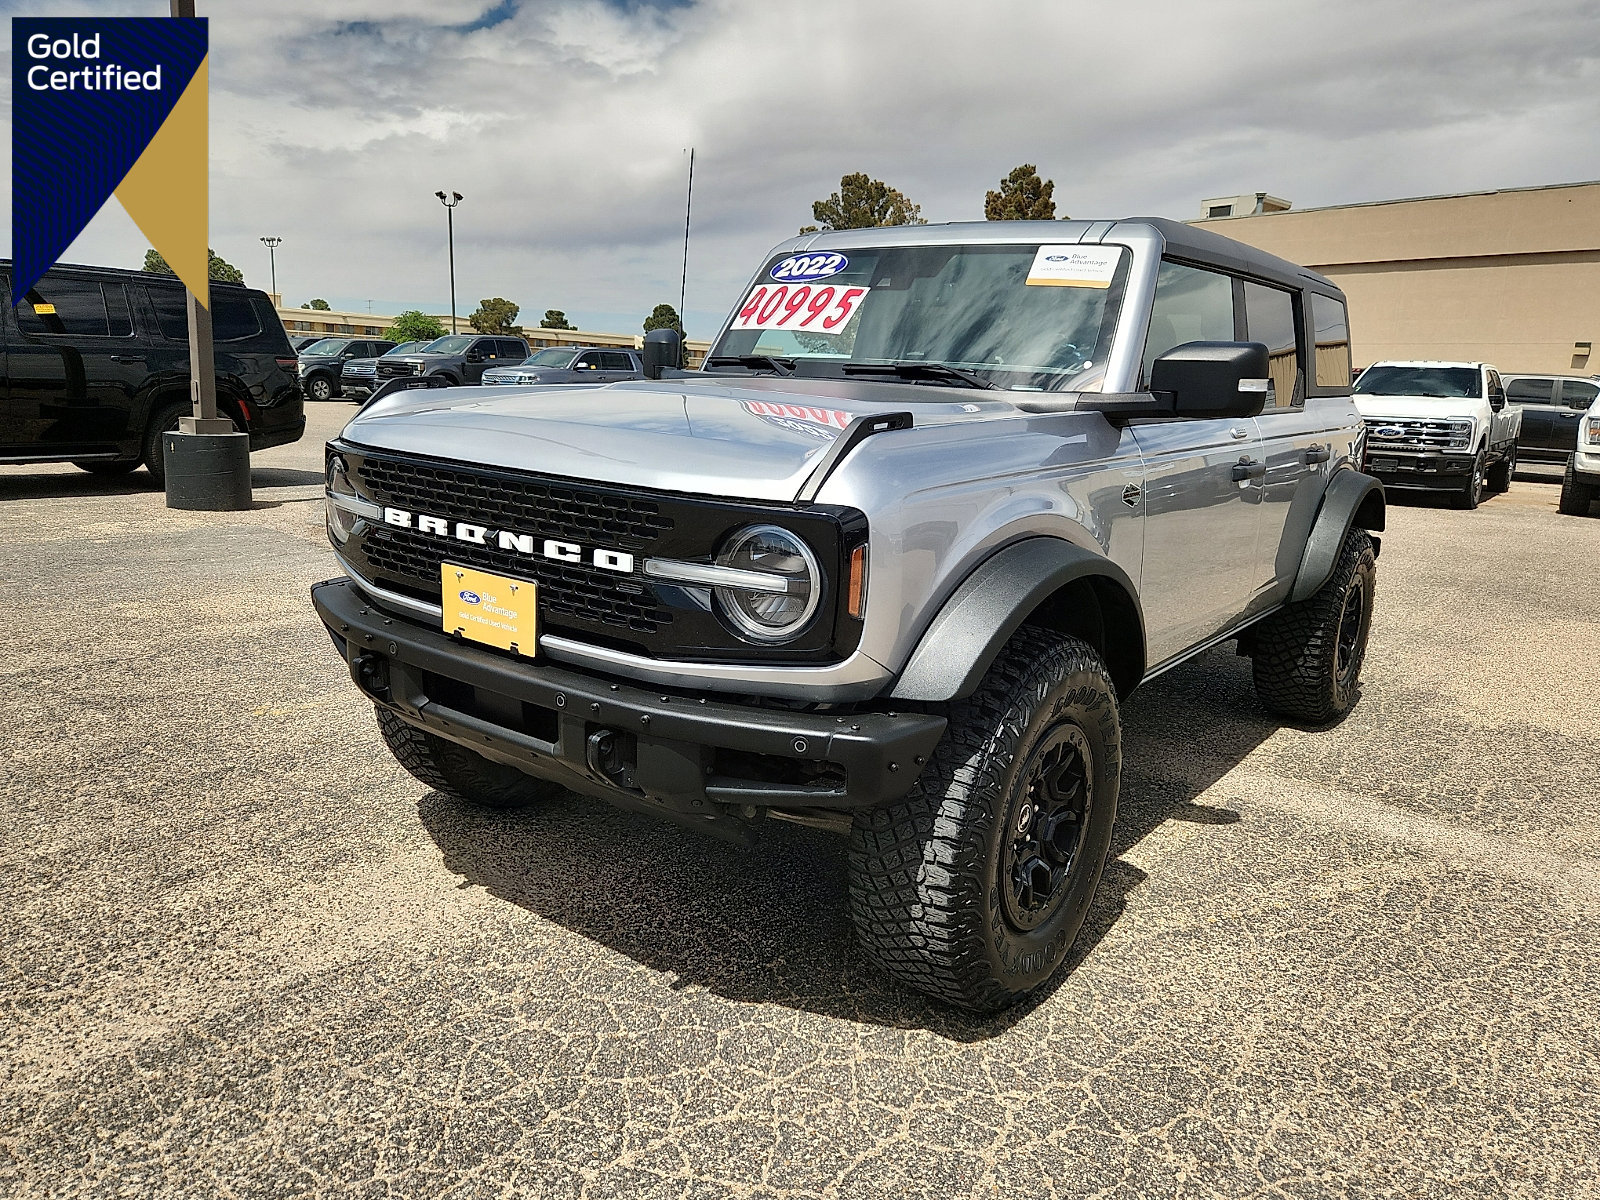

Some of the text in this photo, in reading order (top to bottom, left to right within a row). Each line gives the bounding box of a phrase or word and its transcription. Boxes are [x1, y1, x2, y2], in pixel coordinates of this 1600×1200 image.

[774, 255, 842, 278] 2022
[739, 285, 865, 329] 40995
[384, 507, 634, 573] BRONCO
[482, 592, 497, 603] Blue
[482, 602, 518, 619] Advantage
